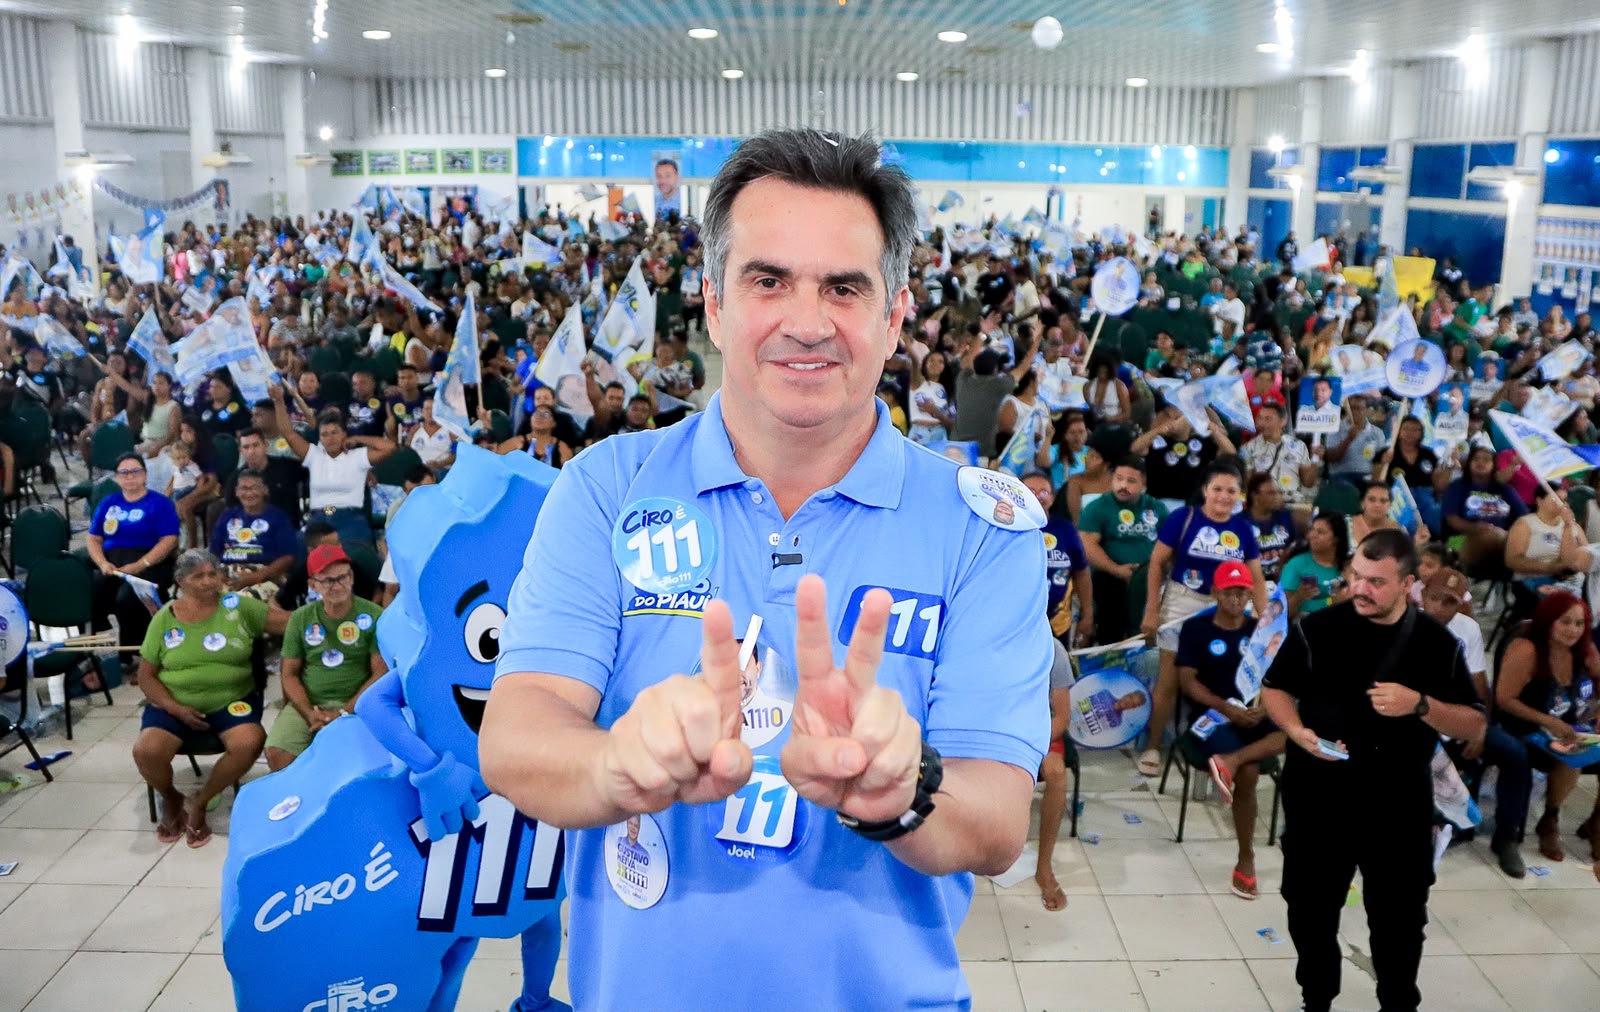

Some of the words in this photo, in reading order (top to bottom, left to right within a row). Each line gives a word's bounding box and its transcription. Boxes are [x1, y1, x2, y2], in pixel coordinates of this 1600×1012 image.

[676, 504, 687, 520] É
[626, 519, 702, 579] 111
[635, 596, 655, 607] DO
[860, 598, 941, 653] 11
[617, 843, 649, 866] GUSTAVO
[727, 844, 756, 860] Joel
[364, 841, 399, 892] É
